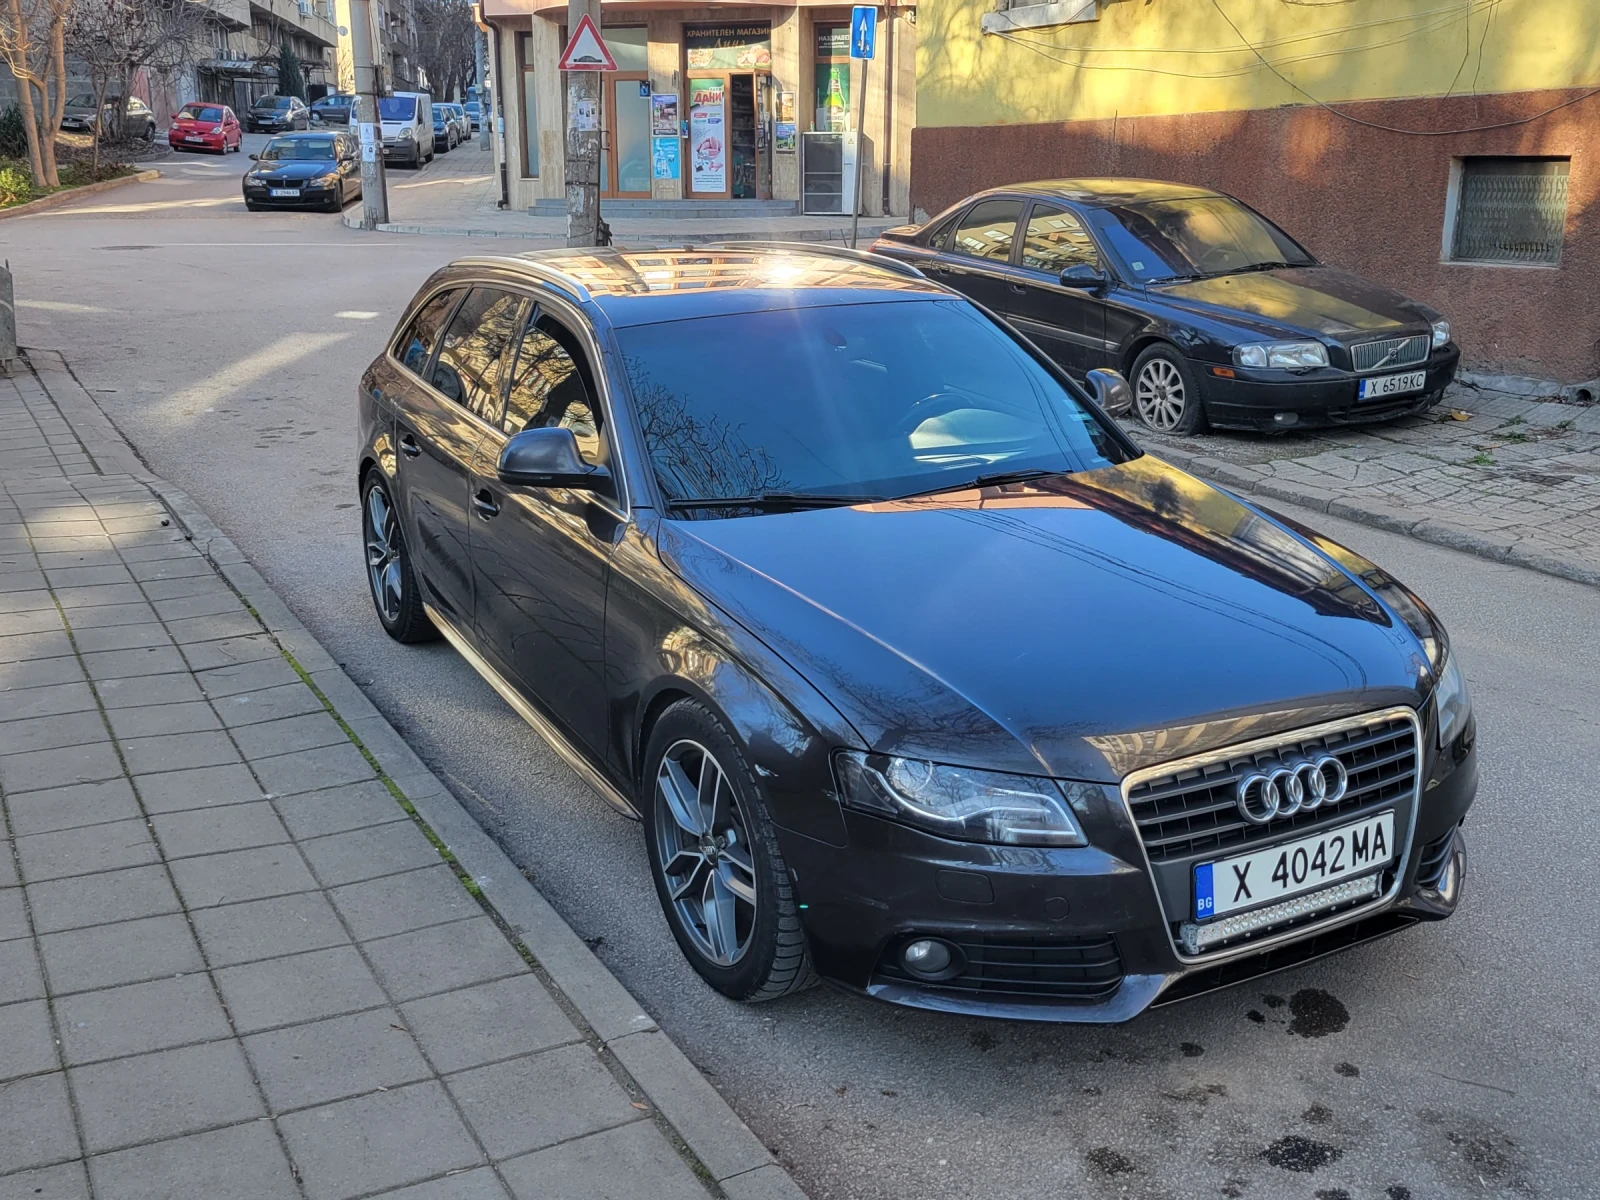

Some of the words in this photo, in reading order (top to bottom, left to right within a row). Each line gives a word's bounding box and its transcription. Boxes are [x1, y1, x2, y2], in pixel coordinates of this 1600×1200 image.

[686, 28, 735, 38] ХРАНИТЕЛЕН
[736, 27, 771, 36] МАГАЗИН
[693, 91, 722, 105] ДАНИ
[1369, 380, 1378, 395] X
[1197, 896, 1213, 910] BG
[1232, 860, 1253, 903] X
